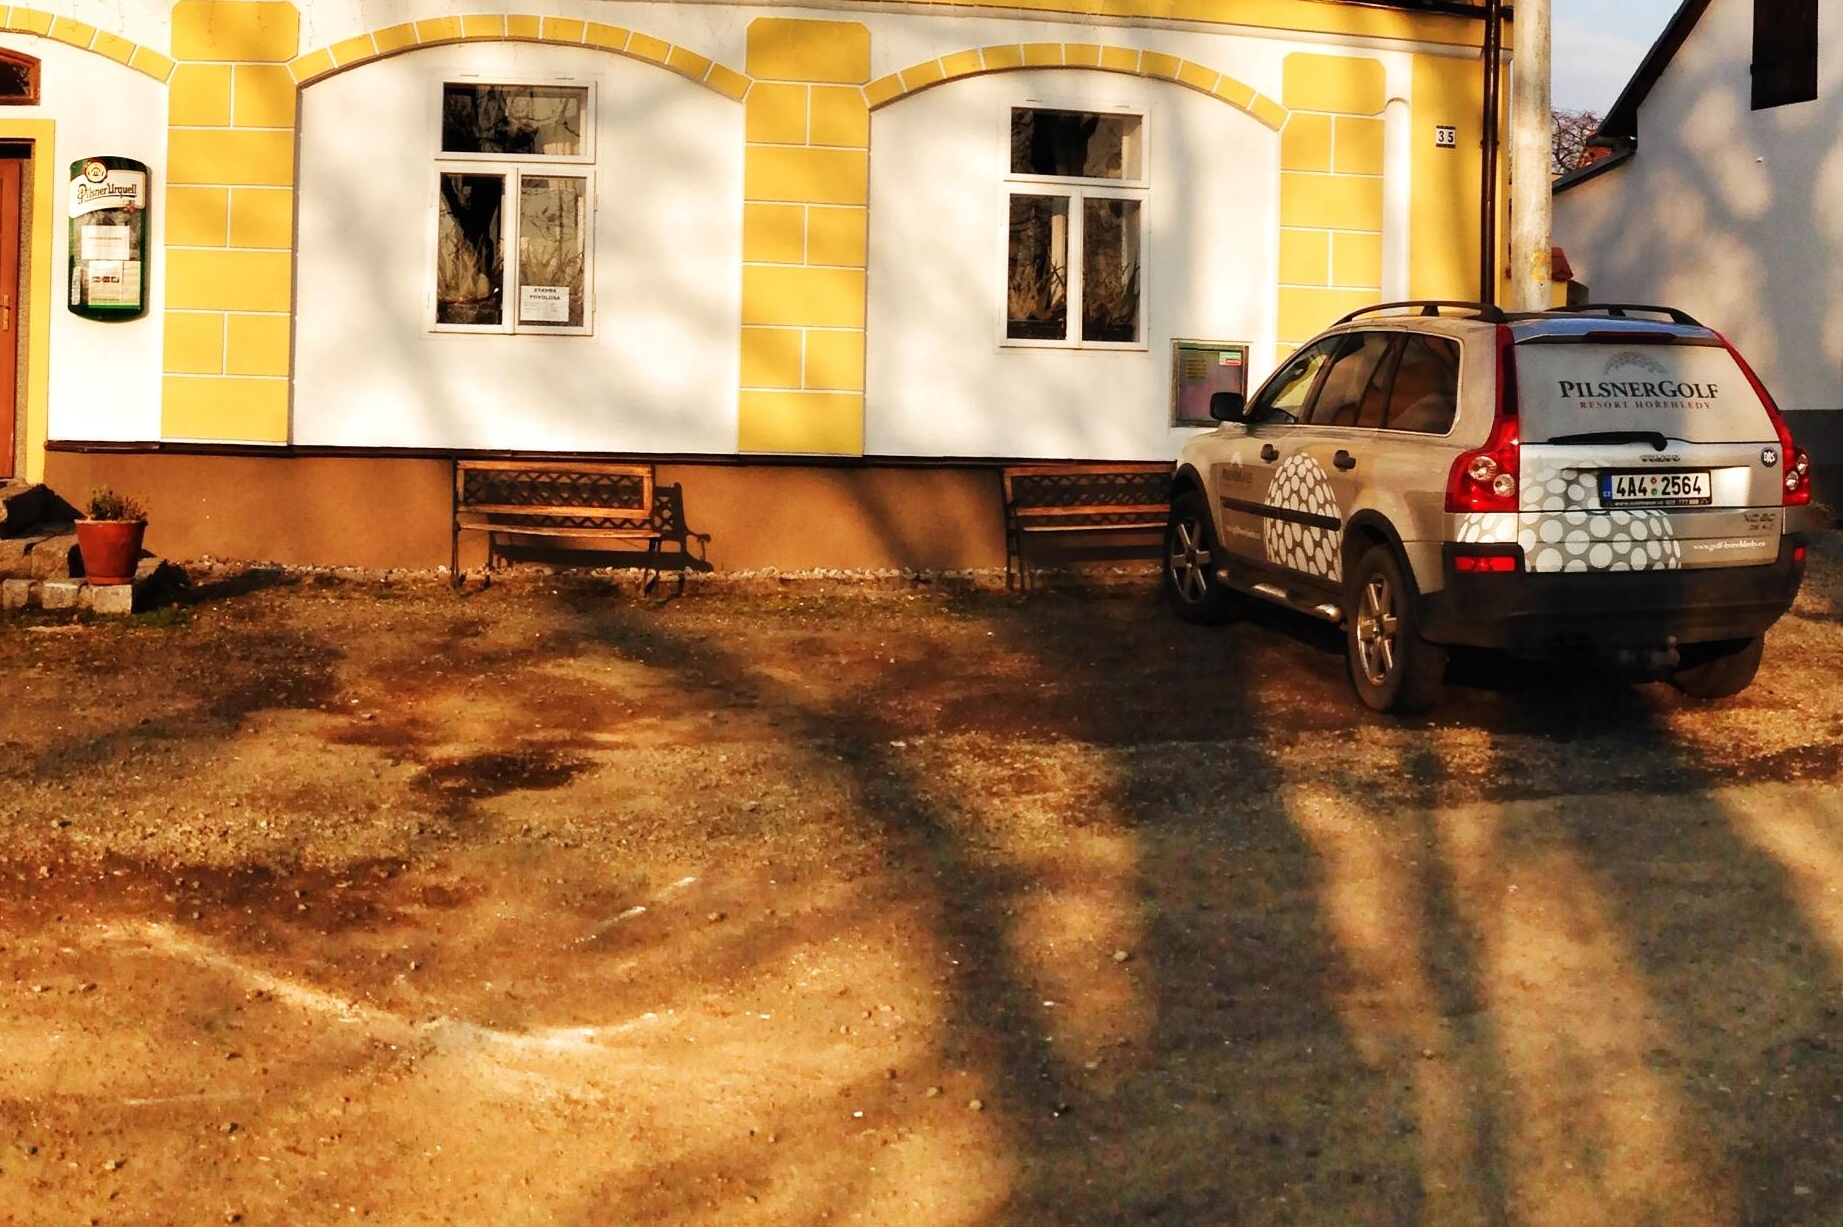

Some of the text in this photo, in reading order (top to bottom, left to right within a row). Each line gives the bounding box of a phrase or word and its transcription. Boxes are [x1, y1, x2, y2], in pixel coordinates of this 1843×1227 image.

[1438, 130, 1454, 143] 35
[77, 182, 137, 204] Pilsner Urquell
[1580, 401, 1628, 410] RESORT
[1616, 475, 1702, 497] 4A4 2564
